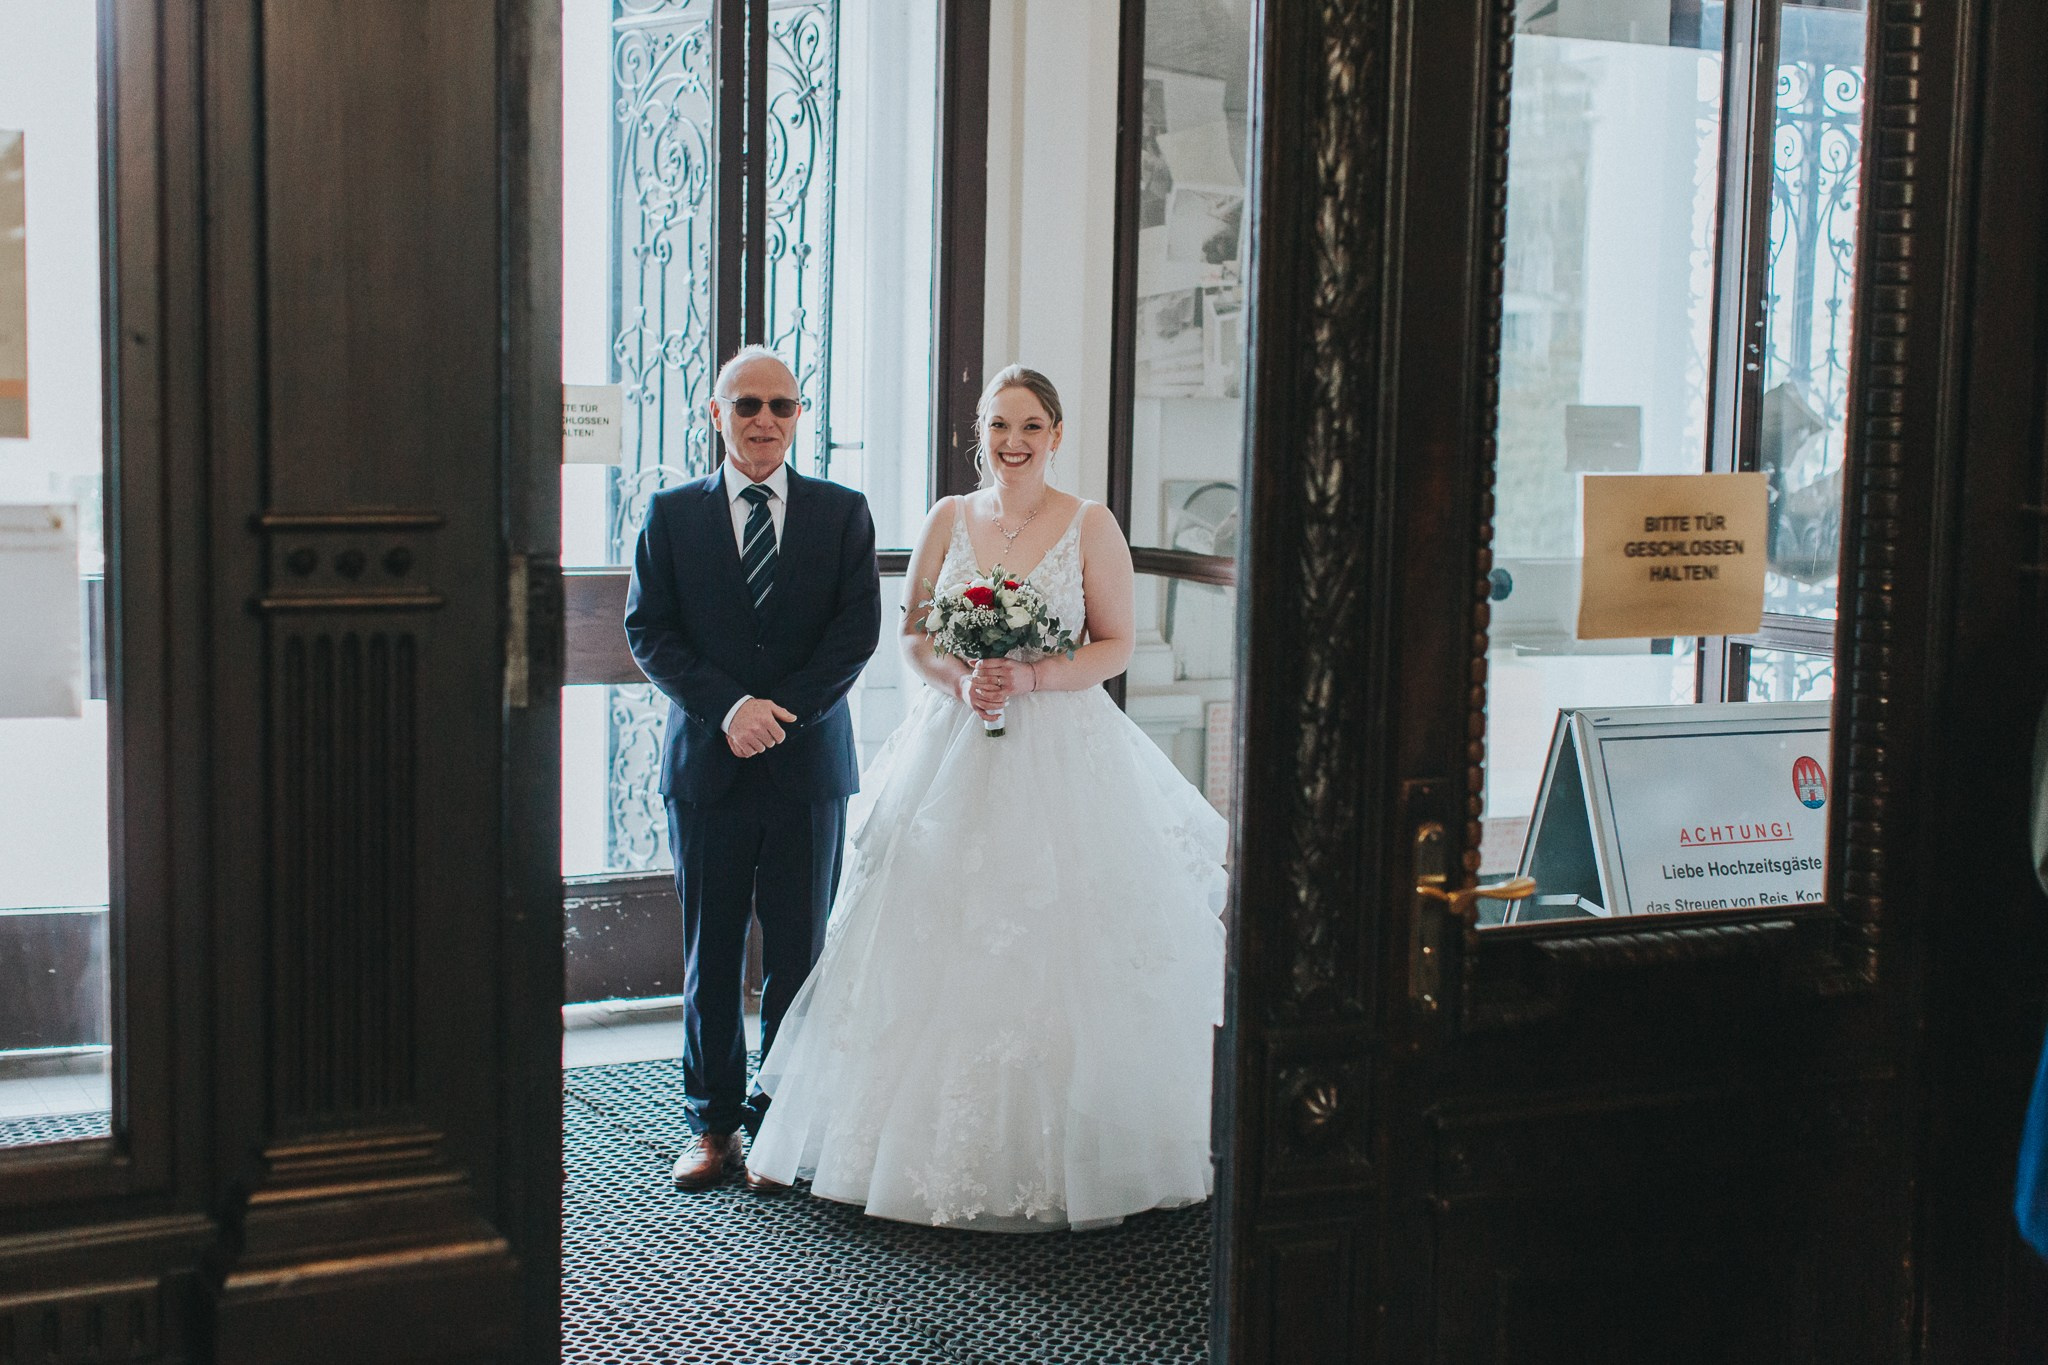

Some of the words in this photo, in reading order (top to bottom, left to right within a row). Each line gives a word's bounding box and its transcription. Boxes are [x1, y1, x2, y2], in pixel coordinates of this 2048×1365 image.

[1645, 516, 1690, 532] BITTE
[1695, 512, 1726, 531] TÜR
[1624, 540, 1743, 557] GESCHLOSSEN
[1649, 565, 1718, 581] HALTEN!
[1680, 822, 1792, 843] ACHTUNG!
[1662, 864, 1704, 880] Liebe
[1708, 856, 1822, 876] Hochzeitsgäste
[1647, 901, 1670, 914] das
[1674, 898, 1727, 913] Streuen
[1730, 898, 1756, 908] von
